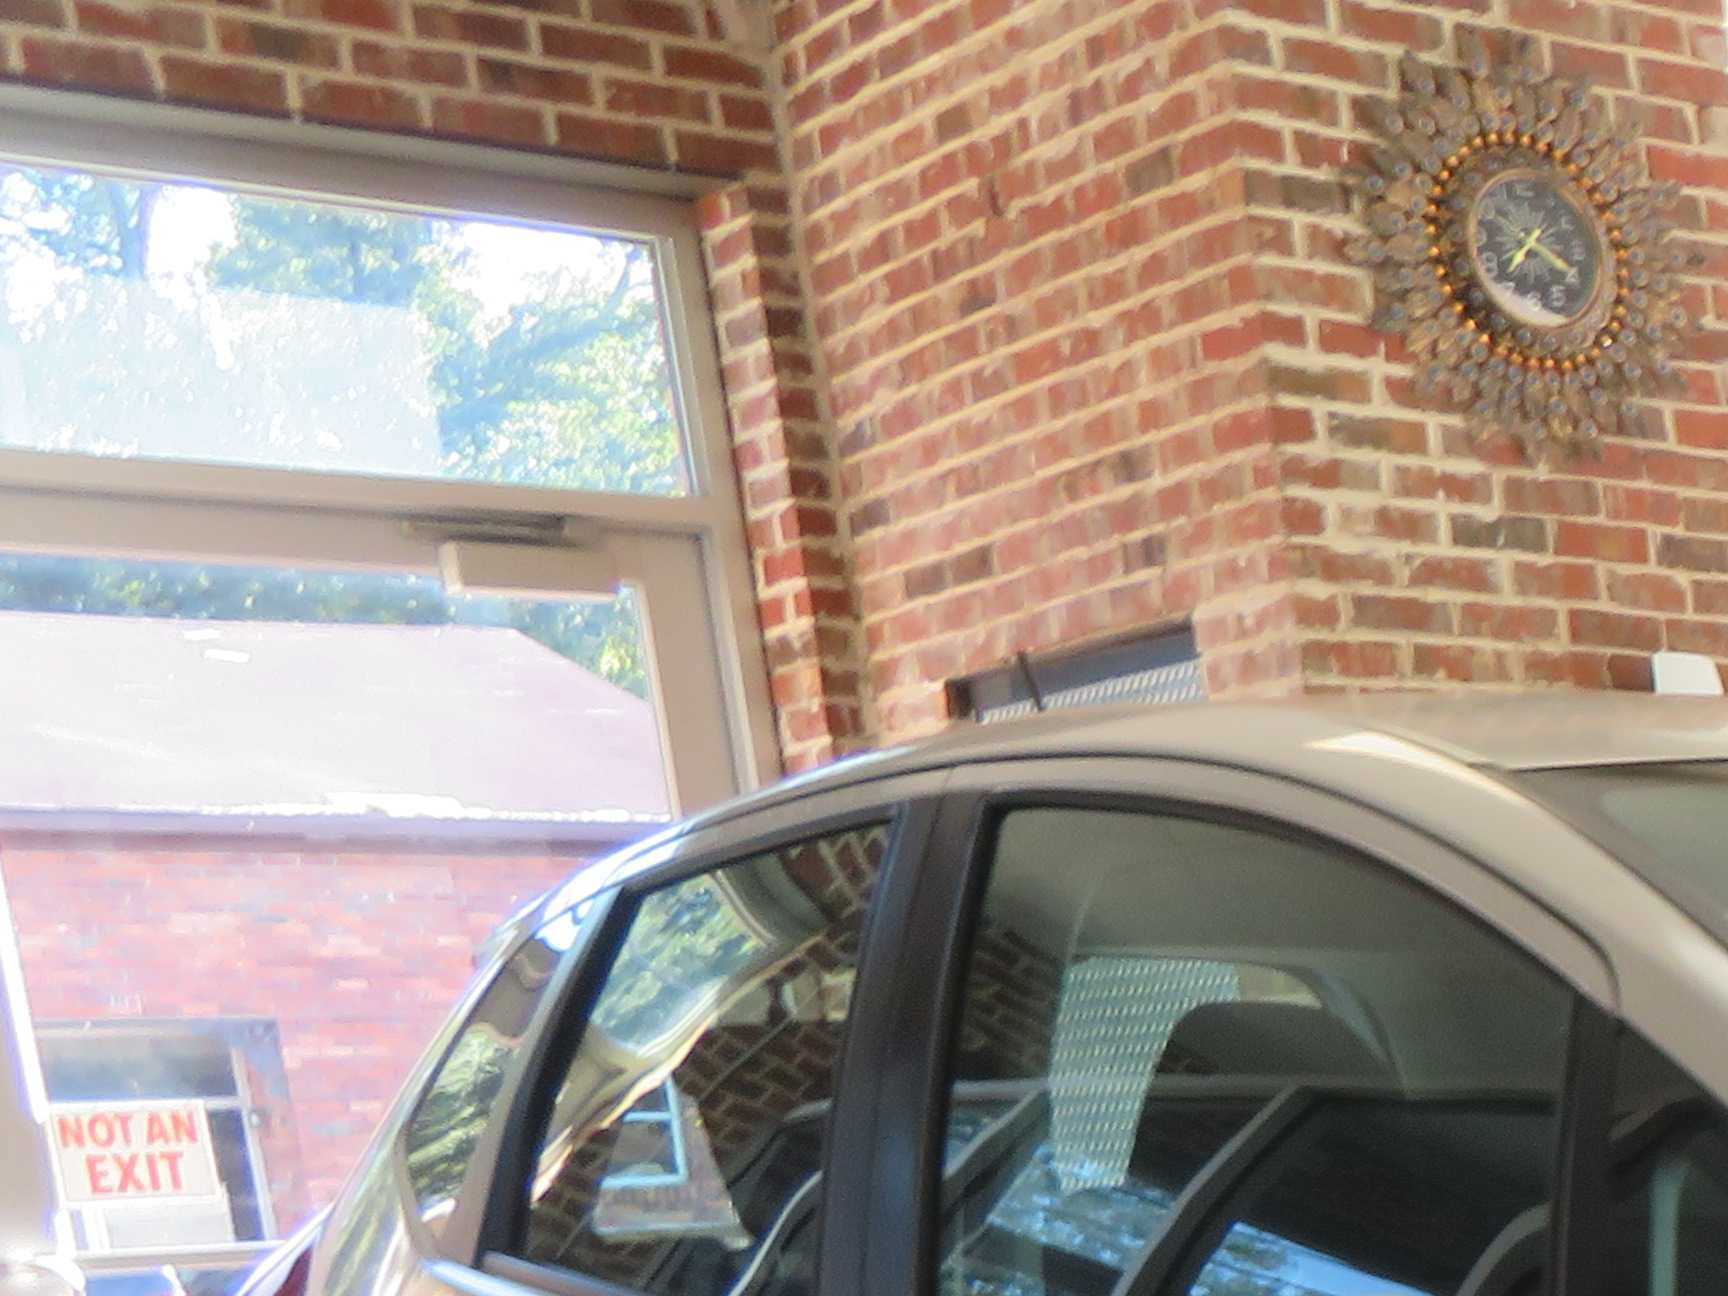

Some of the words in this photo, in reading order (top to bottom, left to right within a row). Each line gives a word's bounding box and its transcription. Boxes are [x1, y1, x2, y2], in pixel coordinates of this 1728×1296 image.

[57, 1112, 133, 1148] NOT
[146, 1110, 198, 1145] AN
[86, 1151, 184, 1194] EXIT
